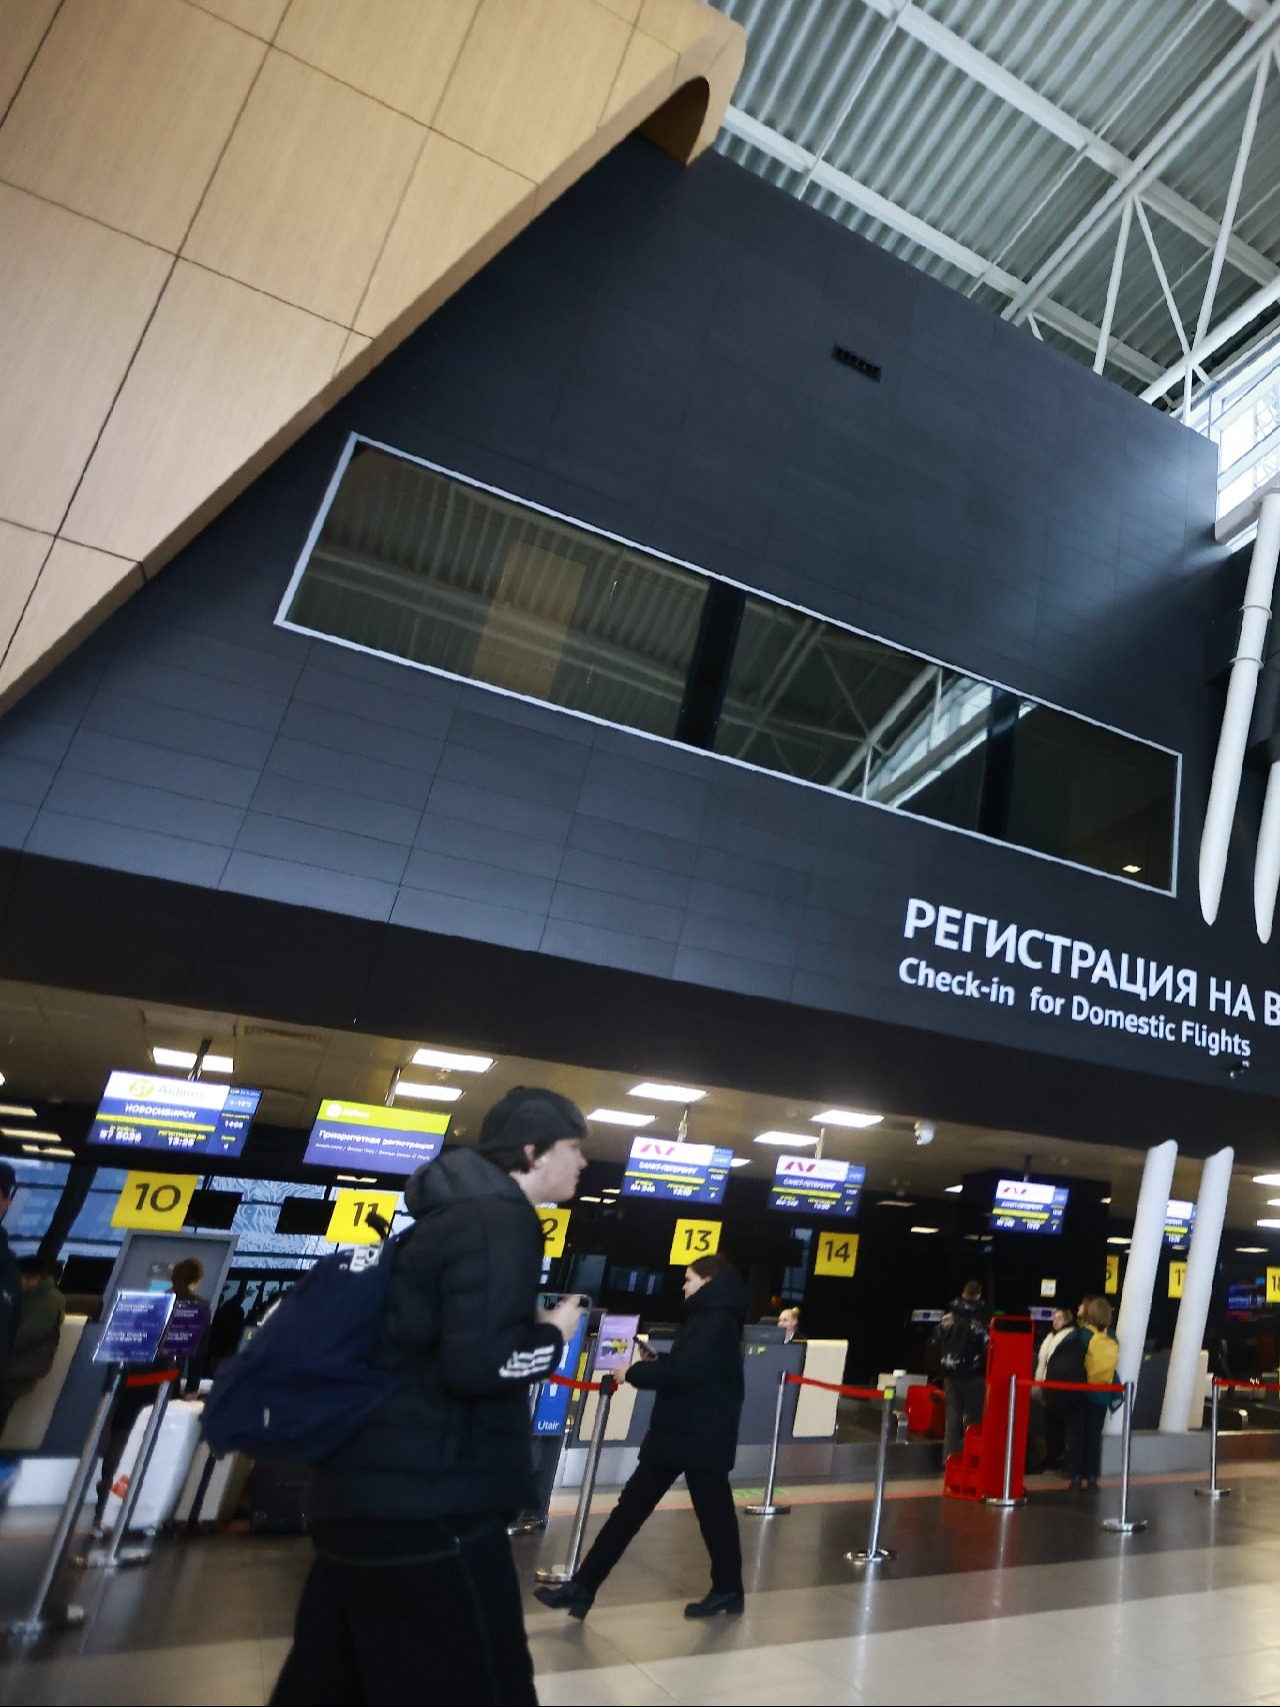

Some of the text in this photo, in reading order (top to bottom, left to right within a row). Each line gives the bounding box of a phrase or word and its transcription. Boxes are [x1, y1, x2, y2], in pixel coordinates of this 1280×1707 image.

[903, 898, 1198, 1008] РЕГИСТРАЦИЯ
[1209, 976, 1256, 1022] НА
[898, 957, 1251, 1057] Check-in for Domestic Flights
[125, 1103, 197, 1119] НОВОСИБИРСК
[318, 1130, 381, 1145] Приоритетная
[381, 1138, 436, 1151] регистрация
[134, 1183, 181, 1212] 10
[353, 1202, 379, 1227] 11
[685, 1229, 711, 1251] 13
[825, 1240, 851, 1263] 14
[537, 1420, 560, 1431] Utair
